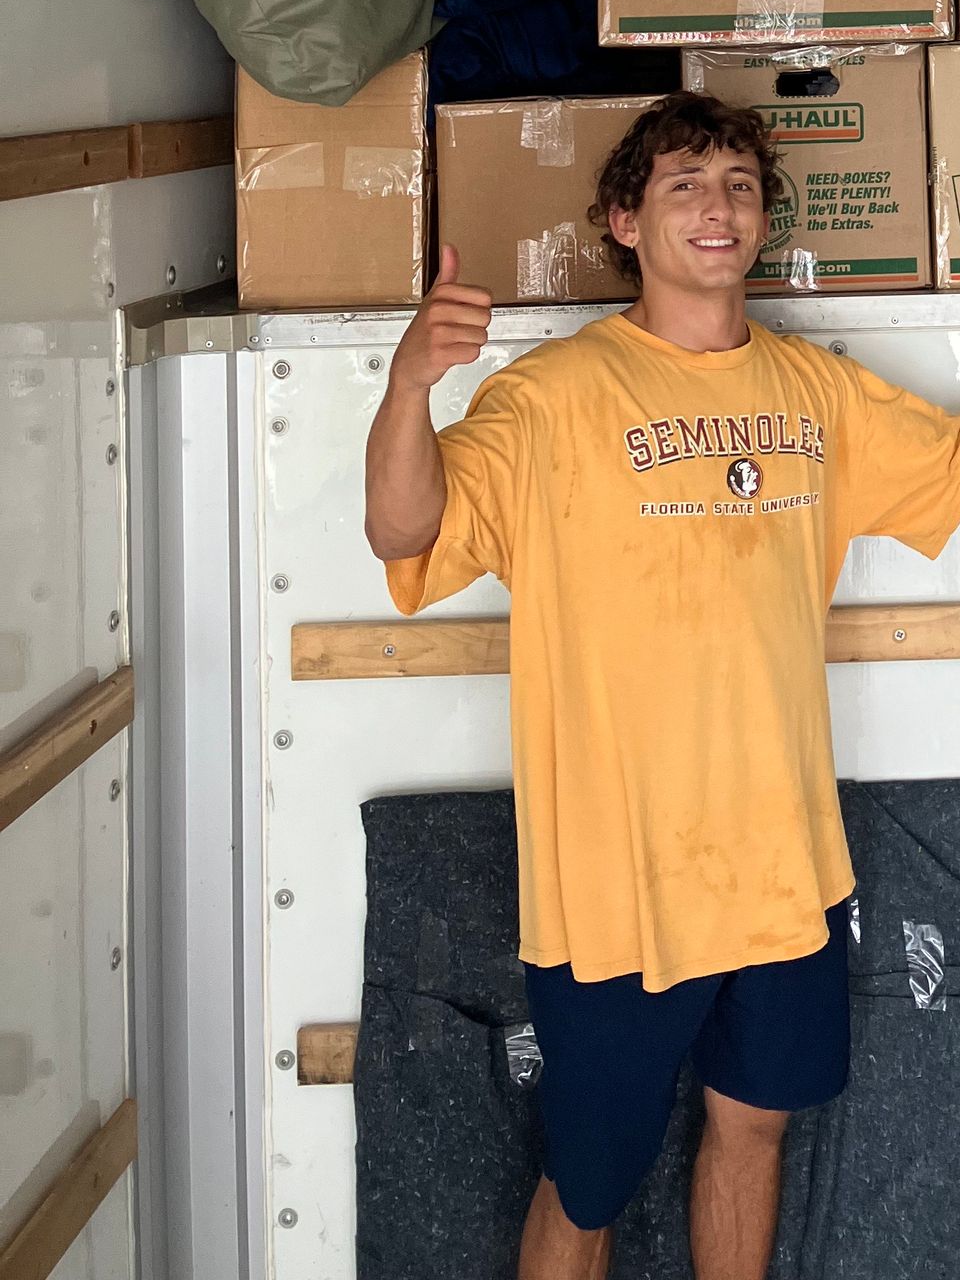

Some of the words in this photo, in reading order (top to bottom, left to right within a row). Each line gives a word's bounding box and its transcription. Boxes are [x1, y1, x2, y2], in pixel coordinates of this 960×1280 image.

[806, 173, 839, 185] NEED
[842, 171, 891, 184] BOXES?
[807, 188, 838, 200] TAKE
[841, 187, 891, 199] PLENTY!
[807, 203, 837, 215] We'll
[840, 203, 865, 217] Buy
[868, 202, 899, 214] Back
[807, 220, 827, 231] the
[831, 218, 874, 230] Extras.
[624, 412, 824, 472] SEMINOLES
[640, 503, 705, 516] FLORIDA
[713, 503, 754, 515] STATE
